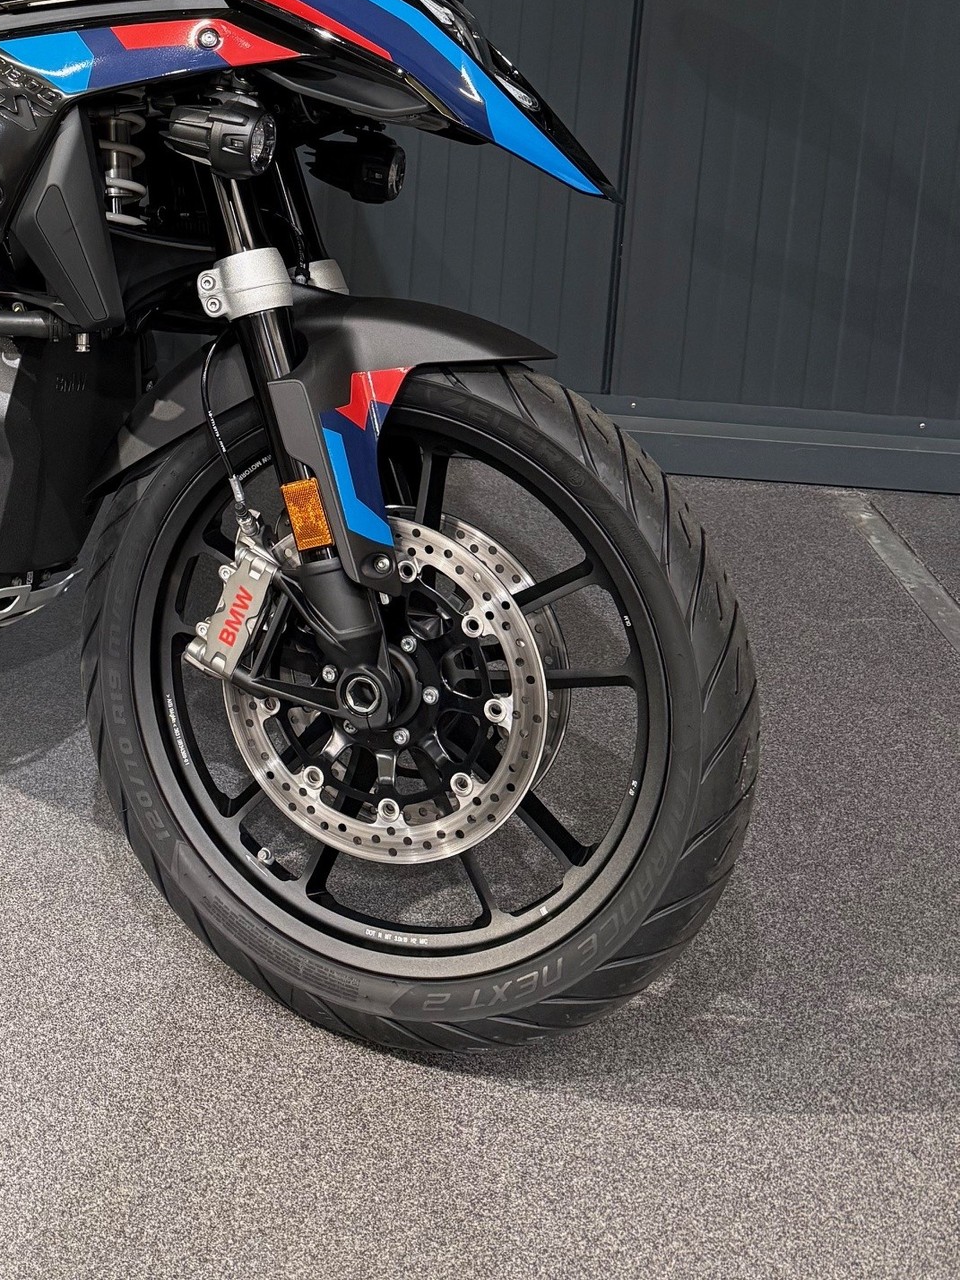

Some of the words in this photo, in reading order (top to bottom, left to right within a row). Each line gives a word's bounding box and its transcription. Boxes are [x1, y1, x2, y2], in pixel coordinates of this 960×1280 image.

[218, 584, 253, 648] BMW
[423, 992, 452, 1011] 2
[459, 956, 564, 1012] NEXT
